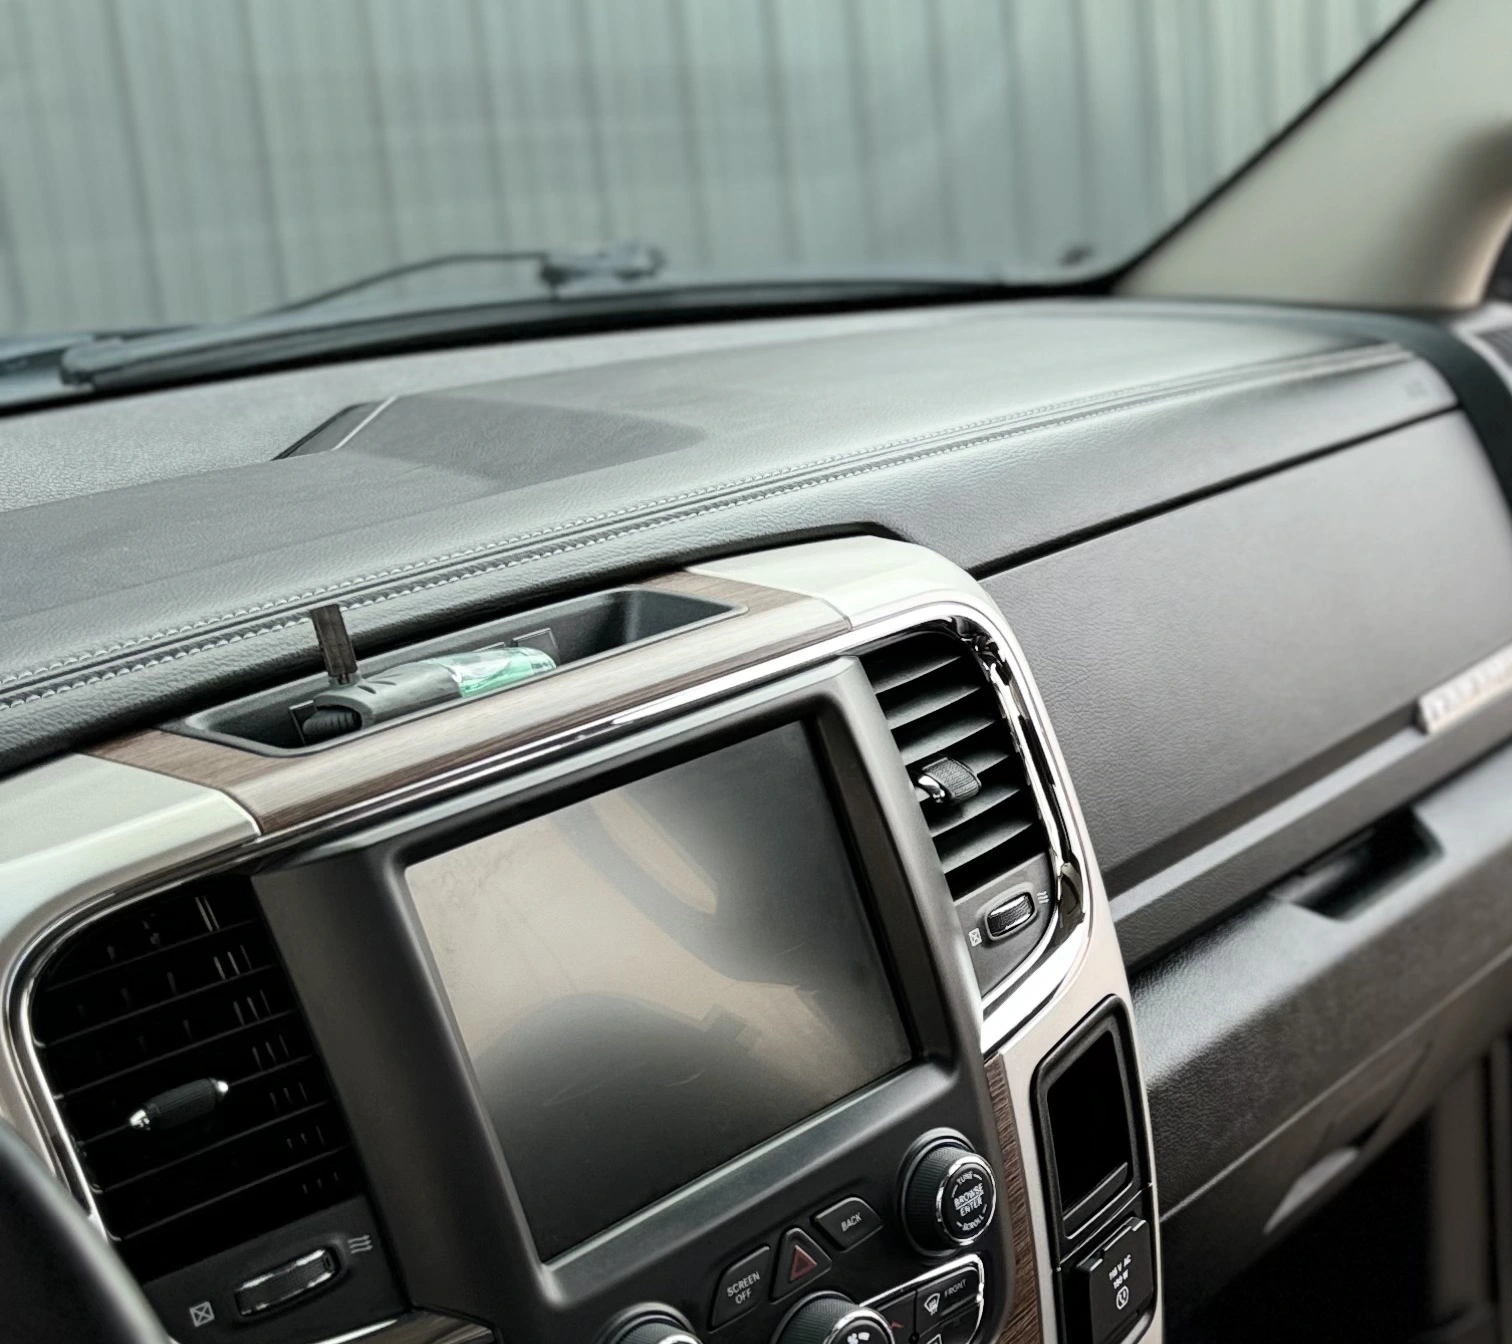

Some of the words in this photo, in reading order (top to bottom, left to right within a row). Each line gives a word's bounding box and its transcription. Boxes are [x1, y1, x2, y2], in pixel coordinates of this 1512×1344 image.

[957, 1170, 973, 1185] TUNE
[953, 1182, 984, 1208] BROWSE
[960, 1196, 982, 1217] ENTER
[840, 1212, 862, 1232] BACK
[962, 1214, 984, 1231] SCROLL
[727, 1270, 760, 1297] SCREEN
[944, 1278, 967, 1298] FRONT
[735, 1289, 753, 1305] OFF
